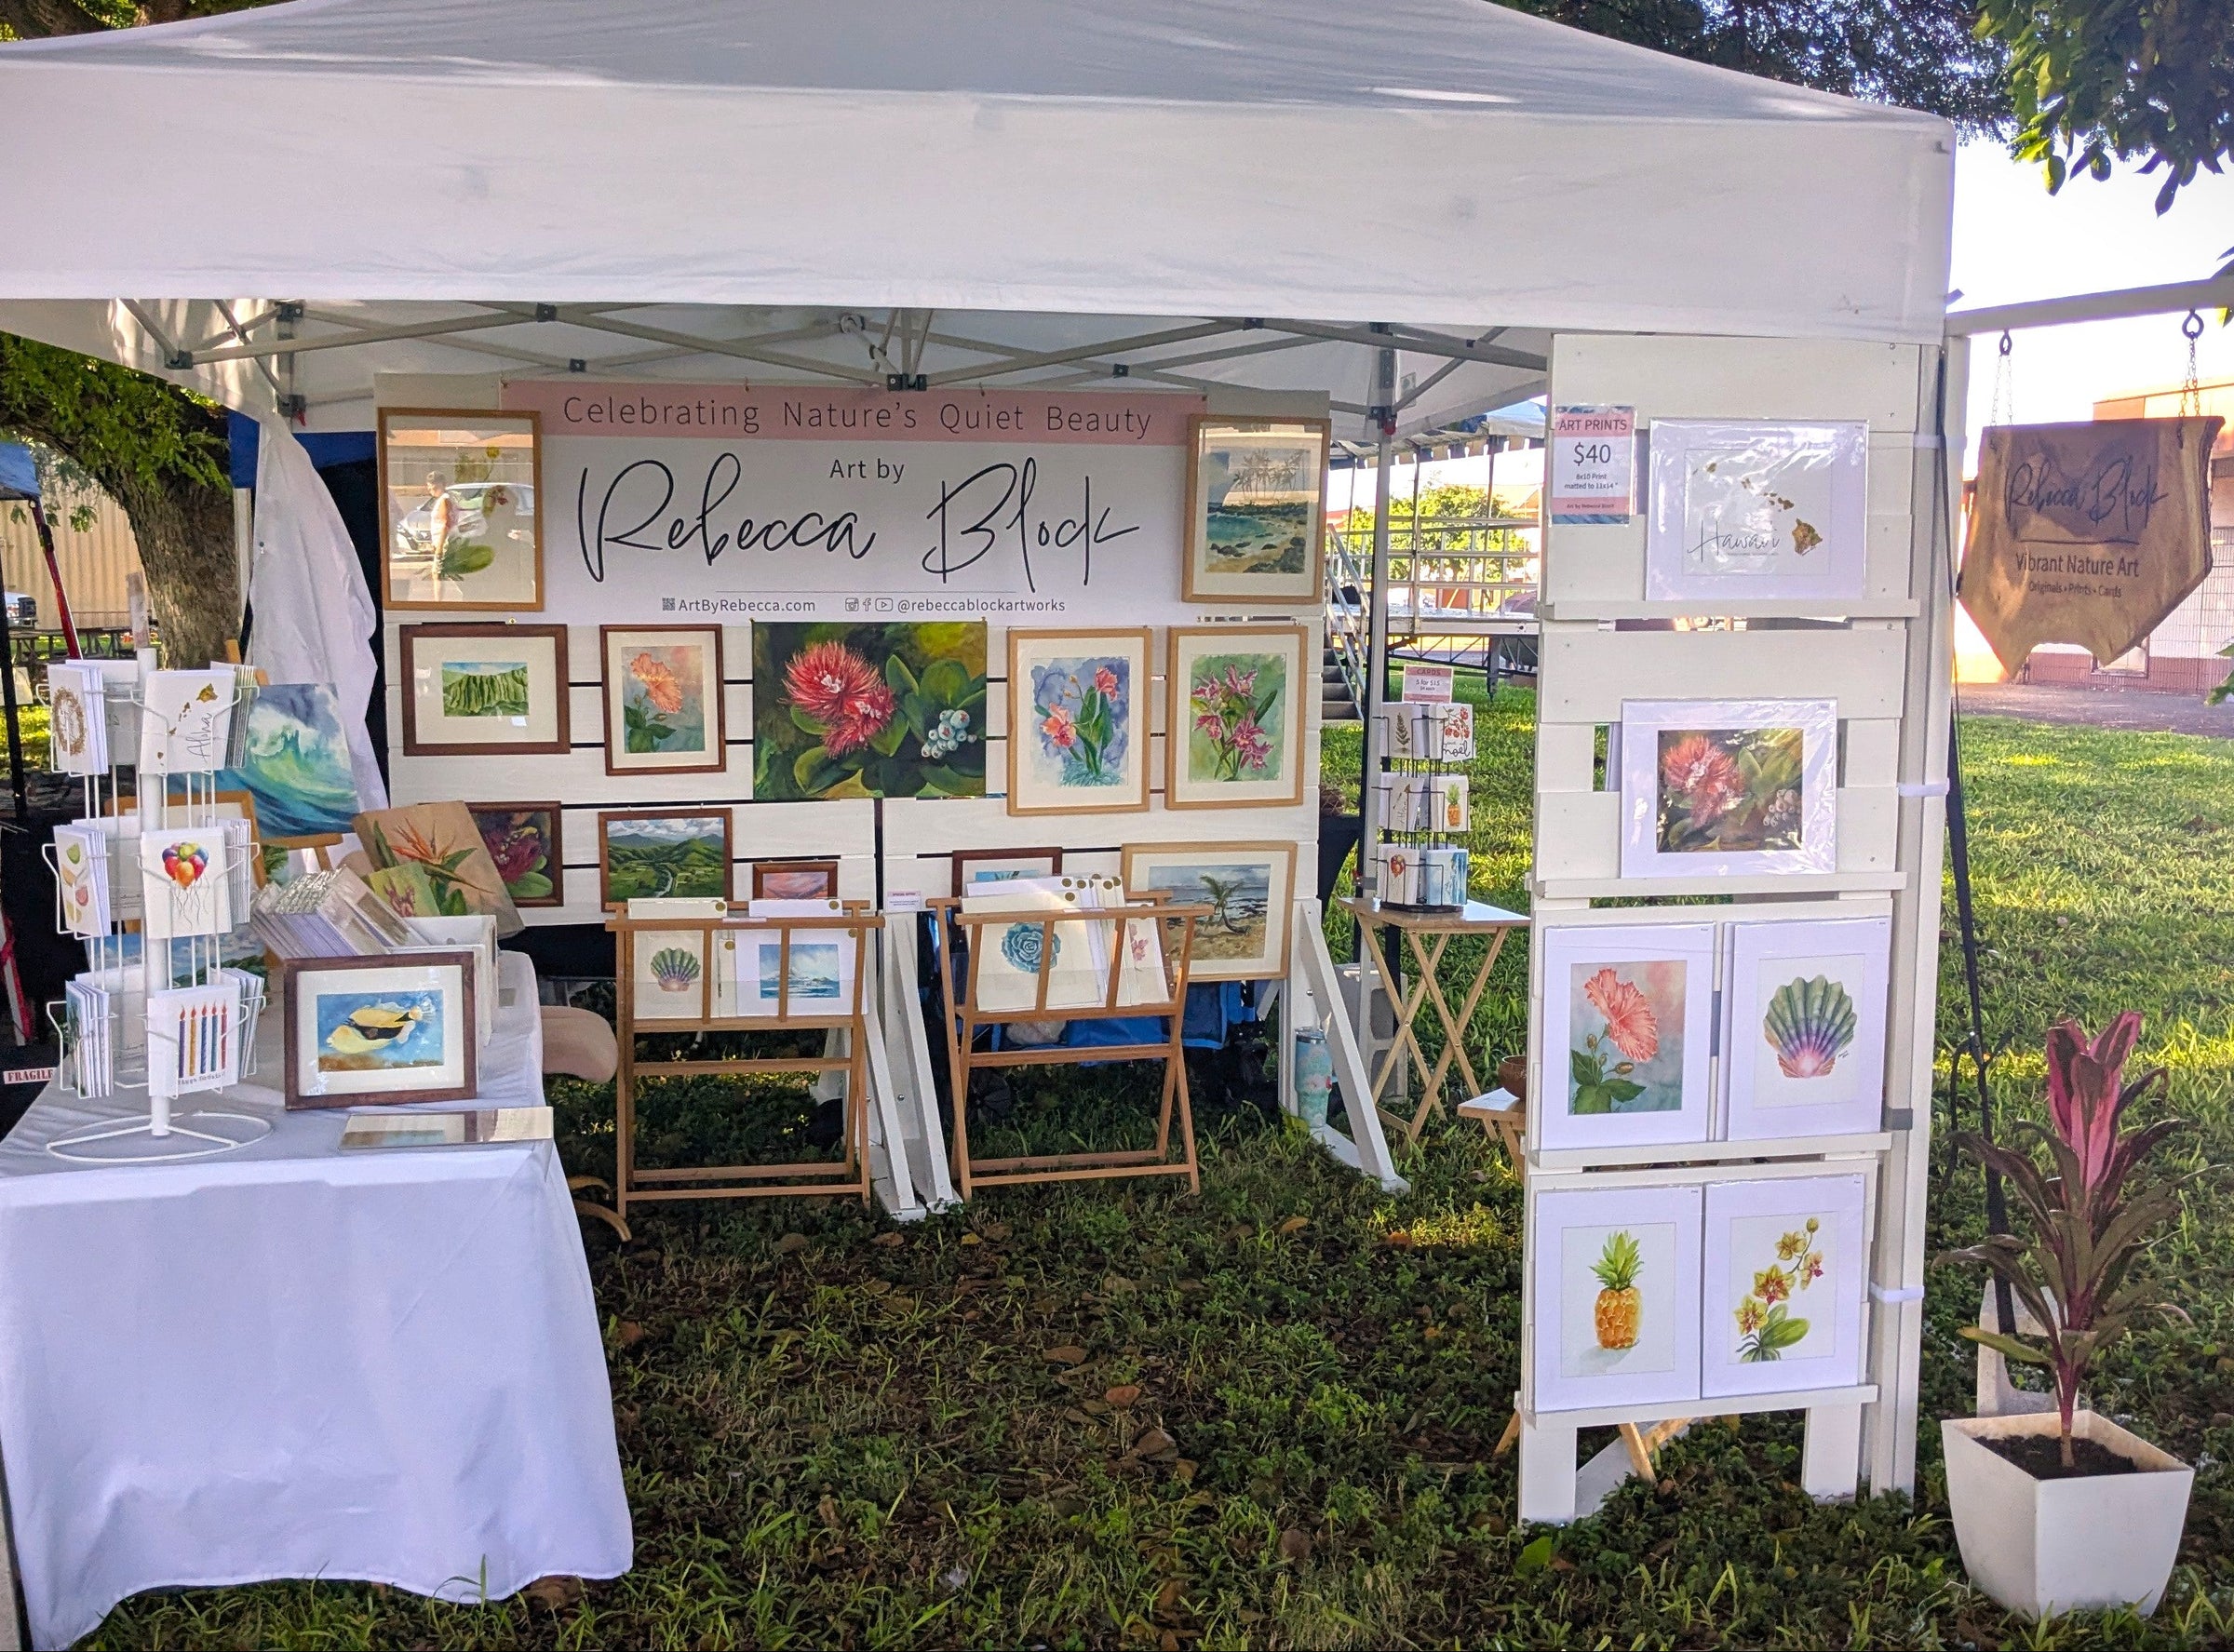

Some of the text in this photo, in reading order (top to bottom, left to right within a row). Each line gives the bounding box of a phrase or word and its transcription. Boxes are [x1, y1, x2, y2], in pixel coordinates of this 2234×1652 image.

[563, 396, 1151, 439] Celebrating Nature's Quiet Beauty
[1558, 419, 1627, 431] ART PRINTS
[1573, 442, 1611, 466] $40
[830, 459, 905, 484] Art by
[577, 452, 1140, 593] Rebecca Block
[2015, 552, 2140, 578] Vibrant Nature Art
[678, 598, 1066, 614] ArtByRebecca.com @rebeccablockartworks
